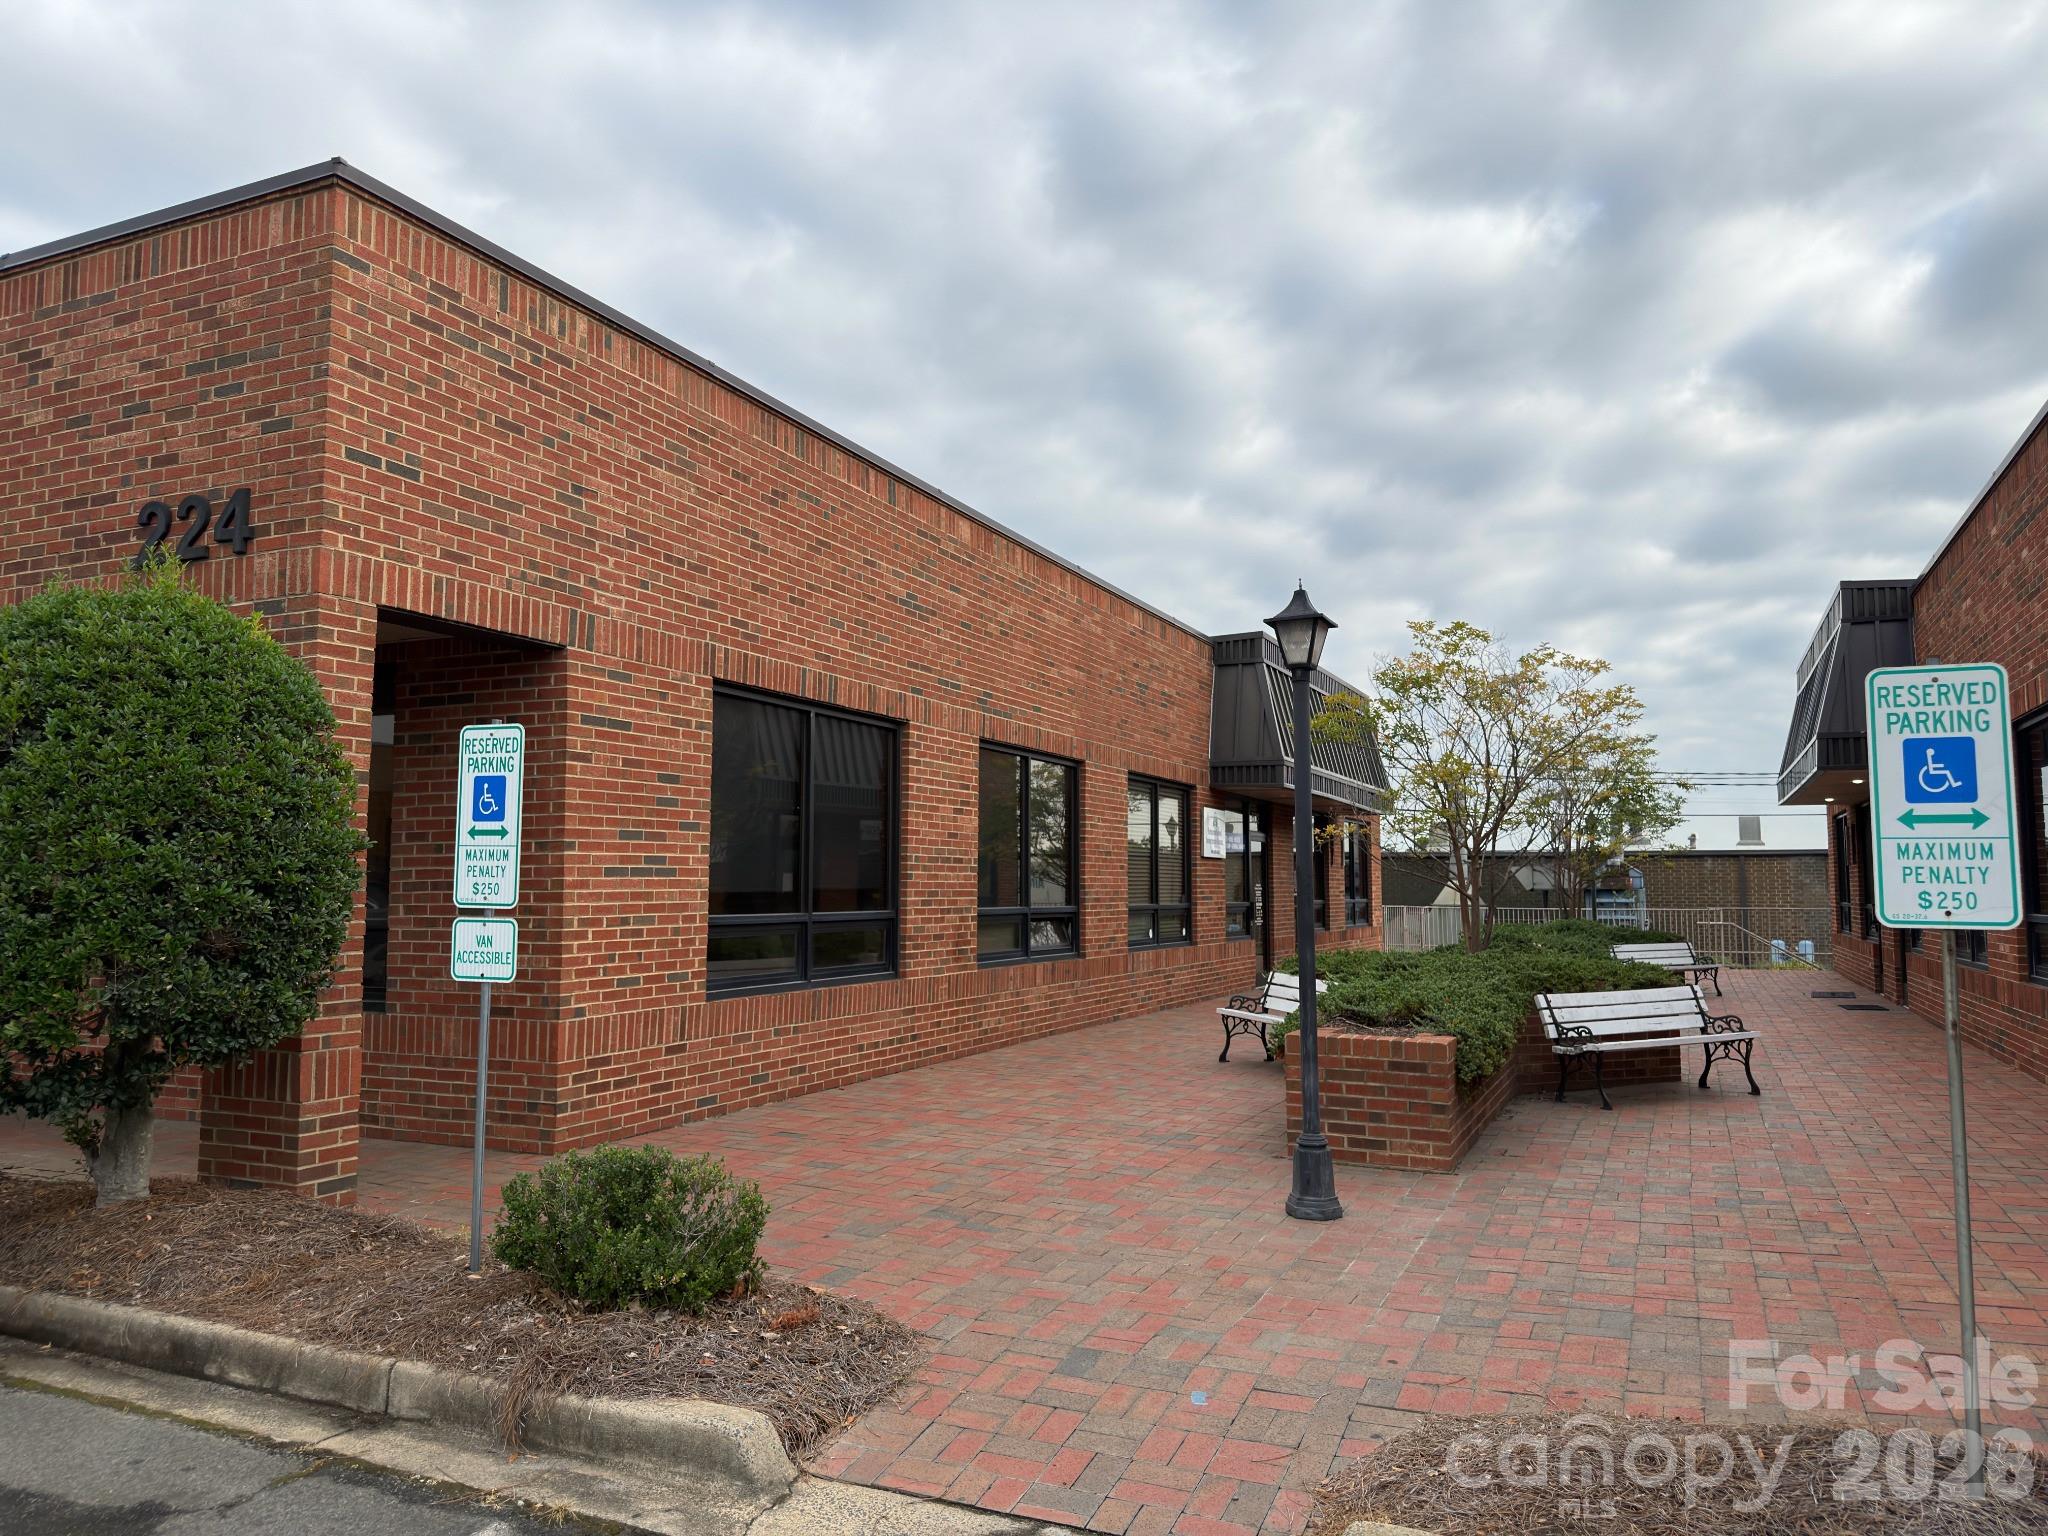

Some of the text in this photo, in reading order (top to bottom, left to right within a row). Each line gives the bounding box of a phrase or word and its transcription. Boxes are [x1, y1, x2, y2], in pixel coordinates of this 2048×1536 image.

[130, 488, 255, 571] 224
[1877, 681, 1997, 708] RESERVED
[1886, 708, 1991, 734] PARKING
[464, 737, 519, 755] RESERVED
[467, 756, 515, 773] PARKING
[465, 849, 509, 862] MAXIMUM
[1896, 842, 1994, 861] MAXIMUM
[467, 865, 507, 878] PENALTY
[1902, 866, 1990, 885] PENALTY
[472, 881, 500, 896] $250
[1917, 890, 1978, 910] $250
[476, 935, 493, 948] VAN
[456, 951, 512, 965] ACCESSIBLE
